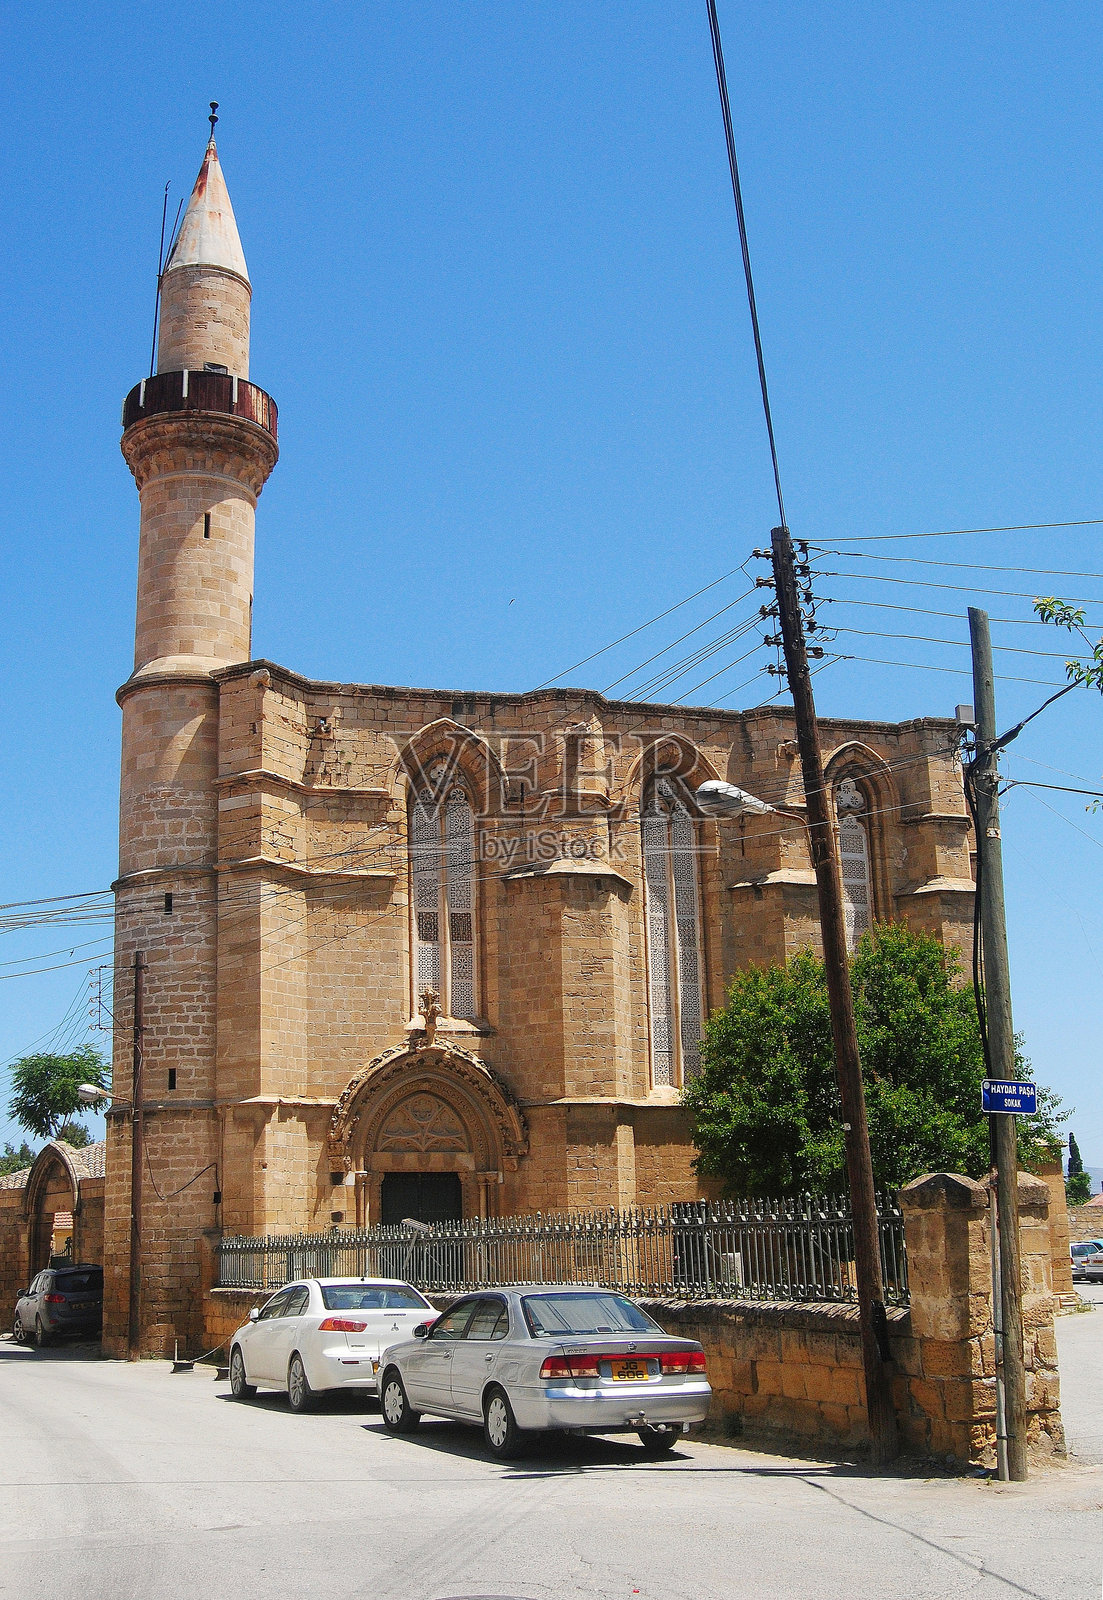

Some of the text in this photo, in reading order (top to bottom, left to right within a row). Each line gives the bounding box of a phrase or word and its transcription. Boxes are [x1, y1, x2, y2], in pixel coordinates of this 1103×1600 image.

[991, 1085, 1035, 1098] HAYDAR PAŞA
[1004, 1098, 1022, 1108] SOKAK
[622, 1361, 638, 1370] JG
[617, 1371, 644, 1379] 606
